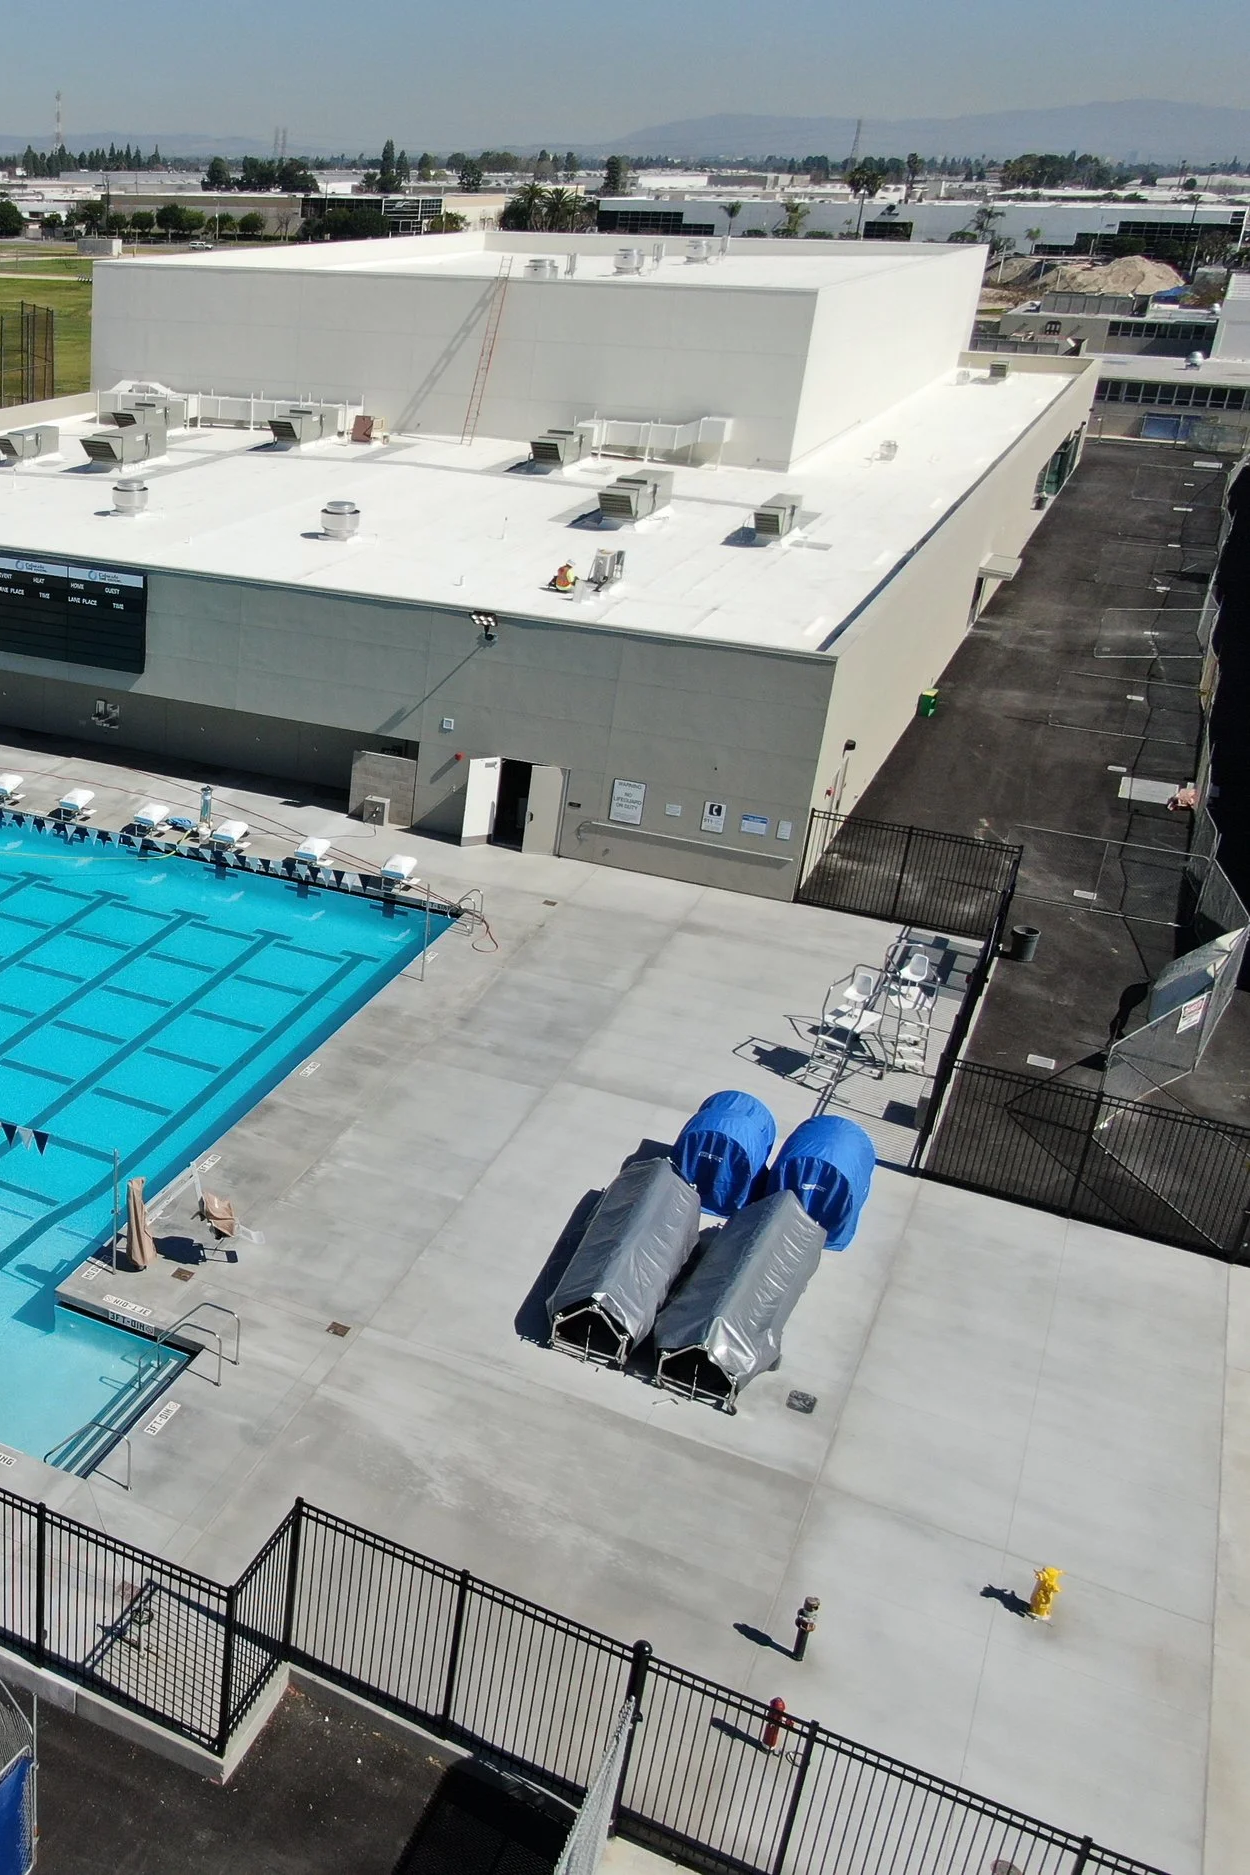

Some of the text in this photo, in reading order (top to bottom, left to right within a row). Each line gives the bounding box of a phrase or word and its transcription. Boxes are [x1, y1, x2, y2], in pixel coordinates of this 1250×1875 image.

[10, 588, 25, 596] PLACE
[67, 596, 81, 604] LANE
[82, 598, 97, 606] PLACE
